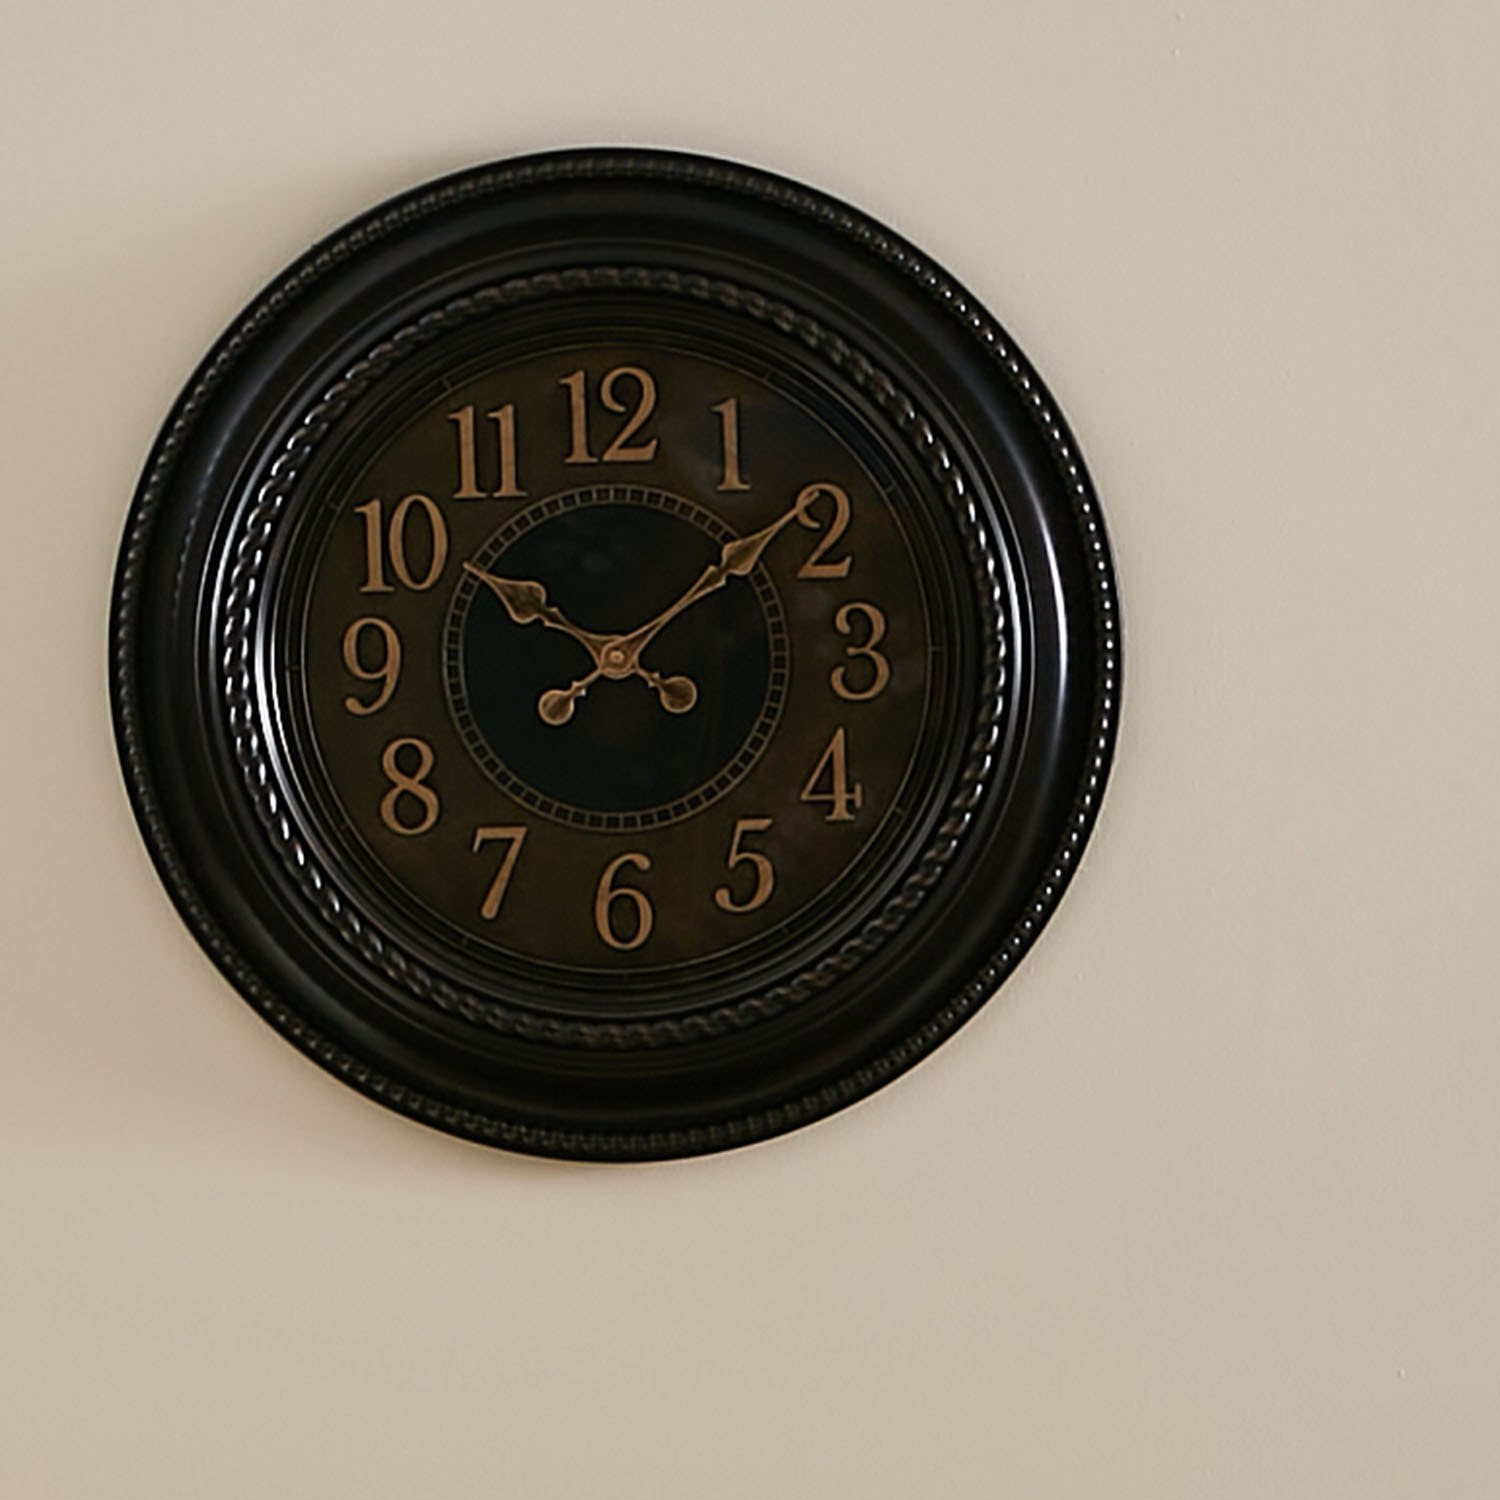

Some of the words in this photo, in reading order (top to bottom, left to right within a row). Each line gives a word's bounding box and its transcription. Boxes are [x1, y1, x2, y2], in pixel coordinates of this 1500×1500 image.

[448, 404, 527, 499] 11
[560, 366, 658, 463] 12
[713, 399, 750, 490] 1
[354, 494, 448, 592] 10
[797, 483, 853, 578] 2
[343, 618, 401, 715] 9
[830, 603, 891, 700] 3
[380, 738, 439, 835] 8
[801, 727, 862, 822] 4
[472, 826, 528, 920] 7
[595, 853, 654, 950] 6
[715, 818, 774, 912] 5
